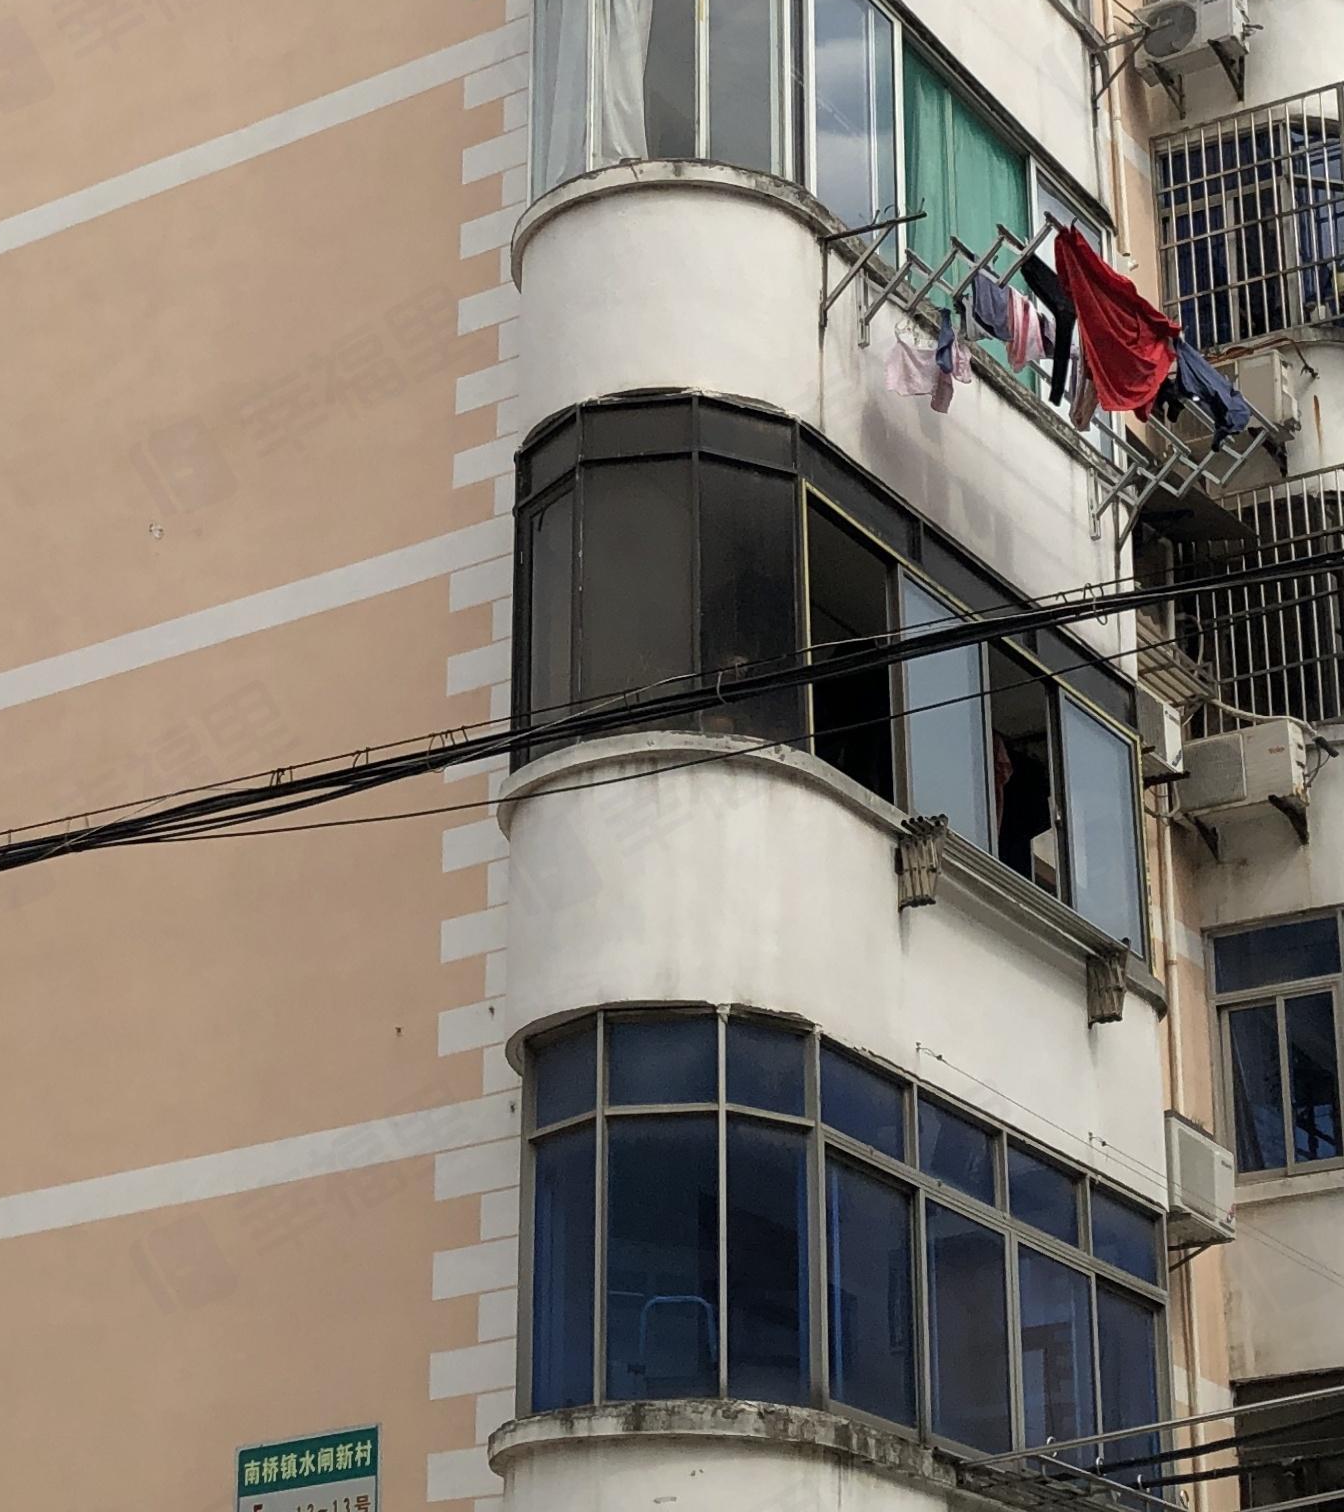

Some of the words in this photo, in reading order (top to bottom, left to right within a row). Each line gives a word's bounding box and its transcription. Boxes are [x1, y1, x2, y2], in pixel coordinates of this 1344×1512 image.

[243, 1439, 373, 1486] 南桥镇水闸新村
